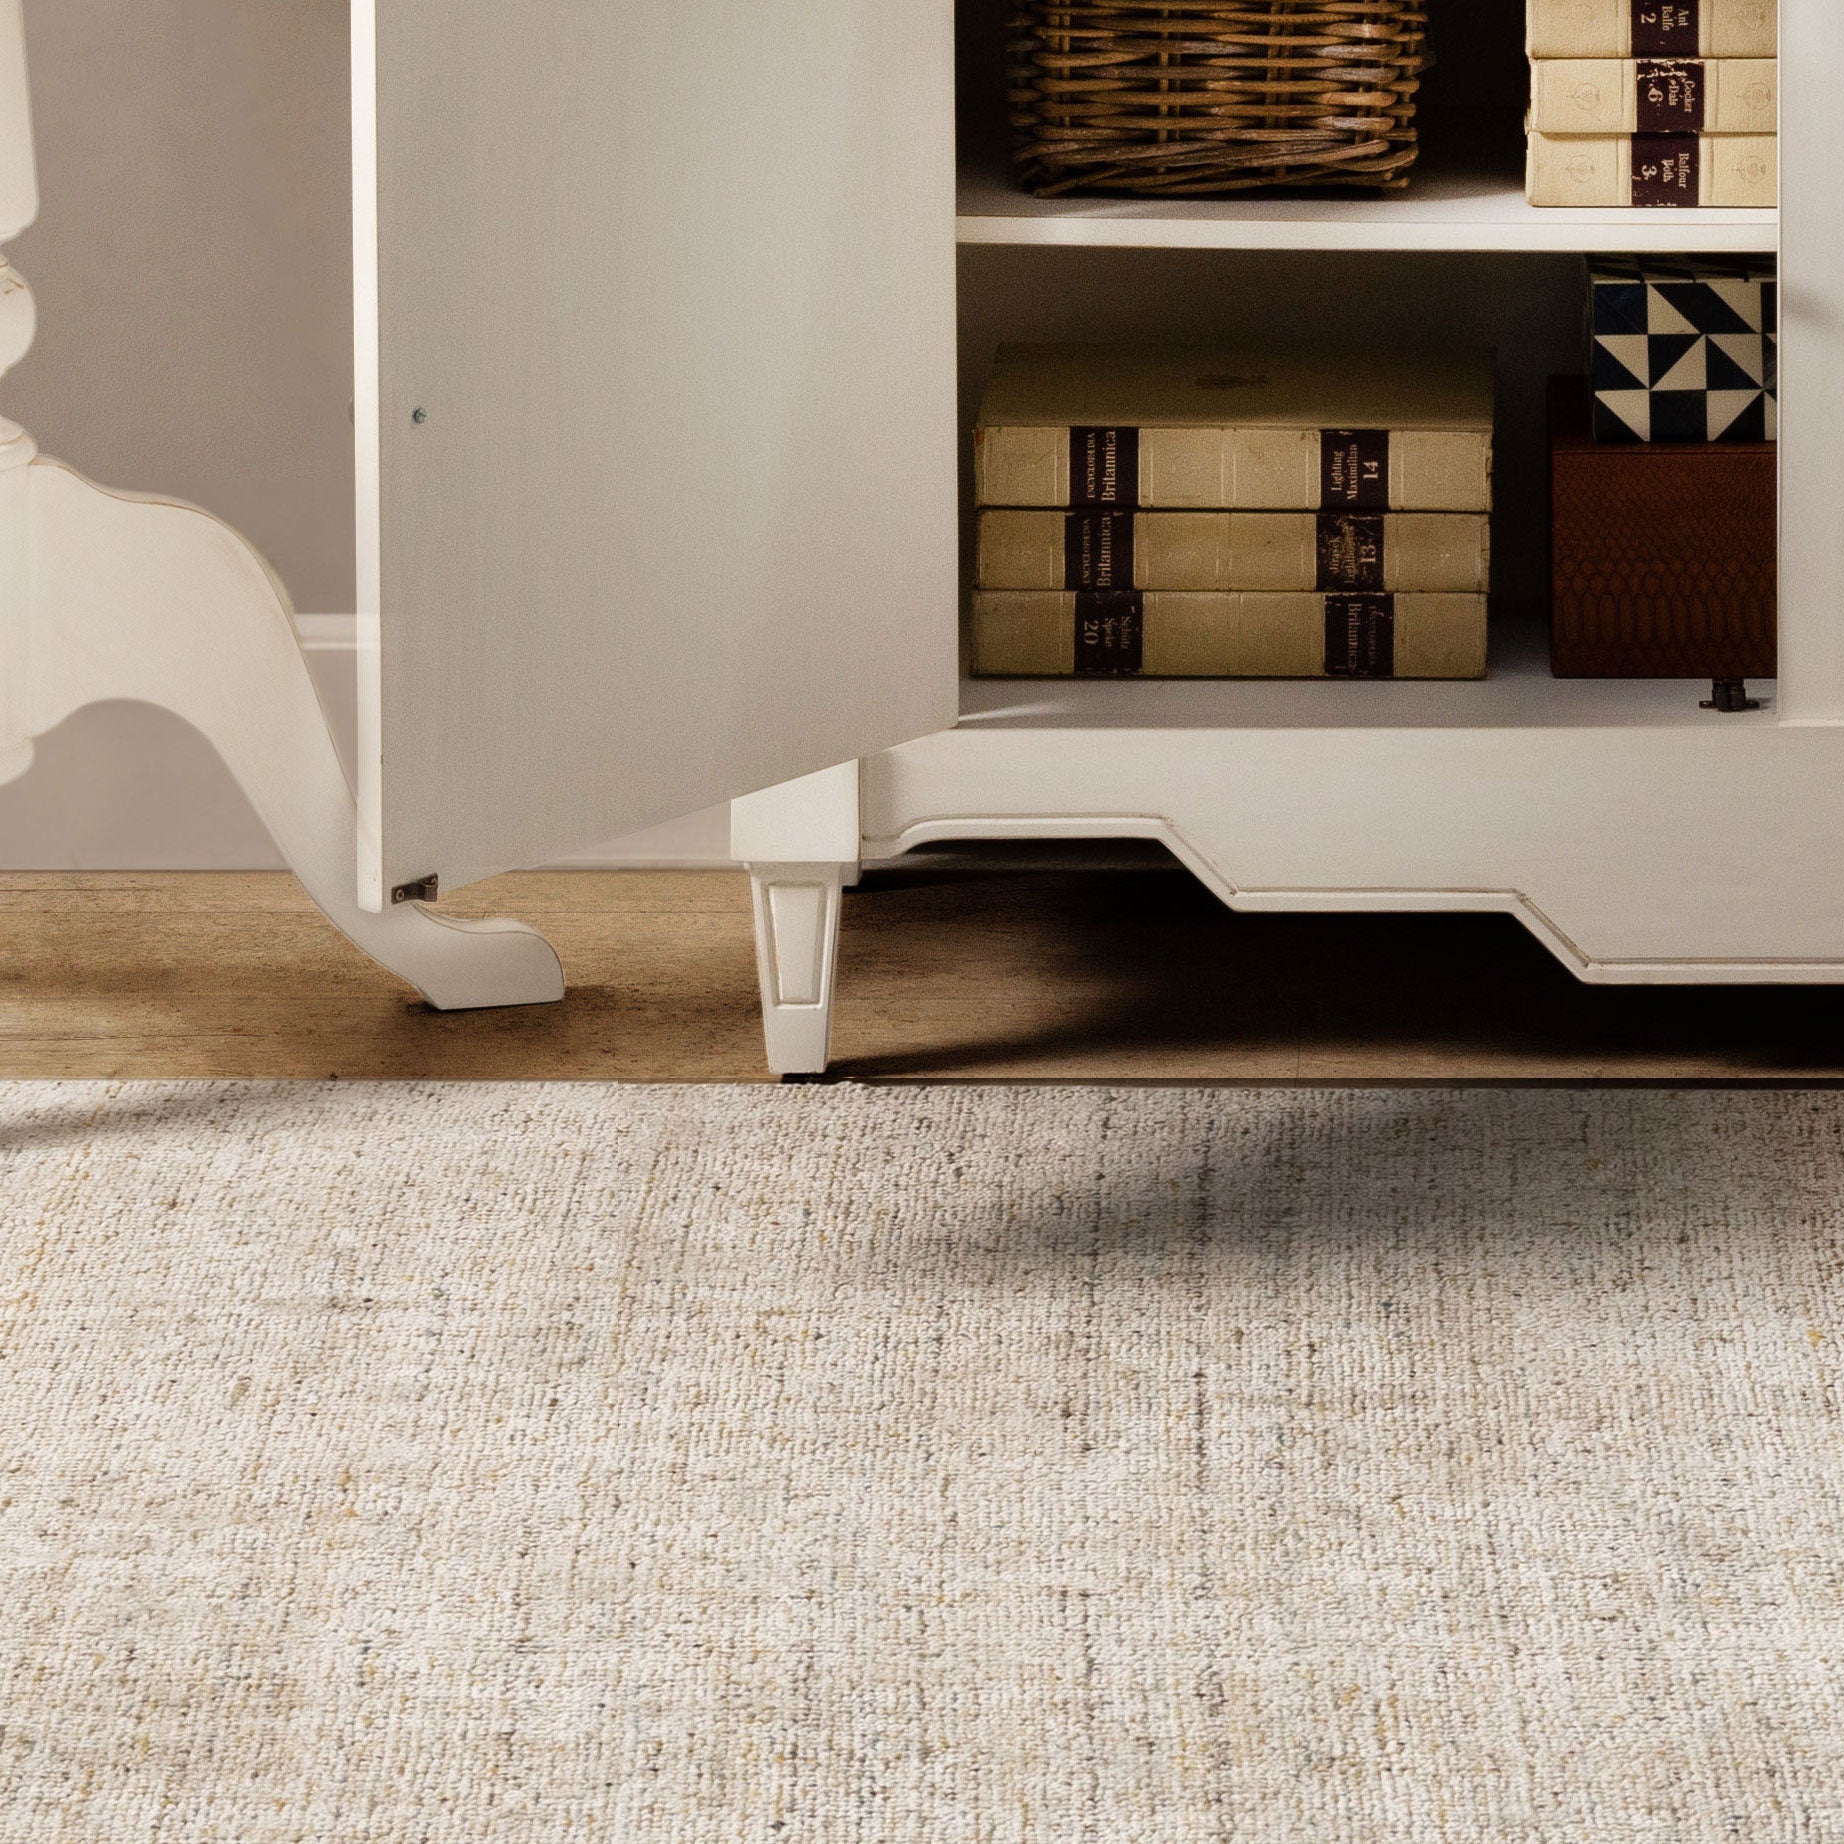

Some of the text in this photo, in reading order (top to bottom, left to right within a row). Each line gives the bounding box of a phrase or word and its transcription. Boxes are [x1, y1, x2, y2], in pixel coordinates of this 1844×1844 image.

[1641, 13, 1656, 24] 2
[1678, 9, 1689, 27] Ant
[1683, 80, 1696, 113] Cocker
[1642, 164, 1657, 179] 3
[1678, 152, 1689, 189] Balfour
[1101, 431, 1116, 501] Britannica
[1330, 450, 1344, 491] Lighting
[1347, 444, 1357, 500] Maximilian
[1363, 460, 1378, 479] 14
[1096, 516, 1111, 586] Britannica
[1084, 620, 1099, 644] 20
